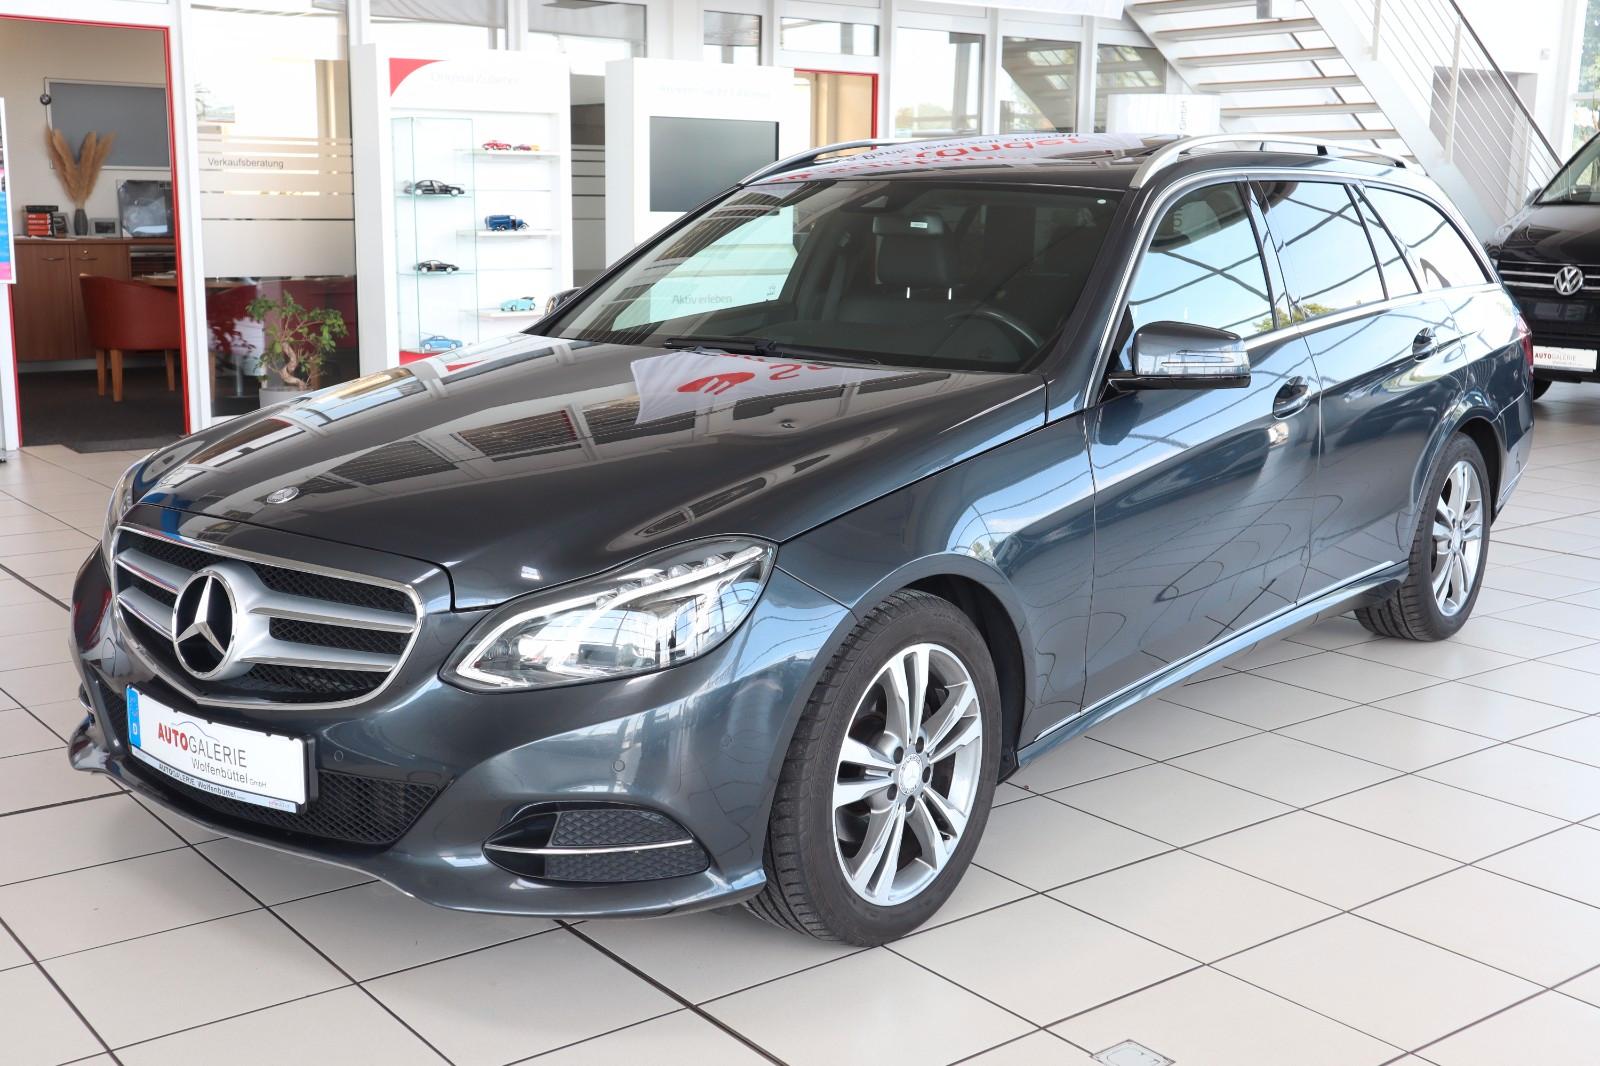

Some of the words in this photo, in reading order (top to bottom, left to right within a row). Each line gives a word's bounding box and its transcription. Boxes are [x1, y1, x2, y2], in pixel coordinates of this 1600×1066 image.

[207, 157, 284, 170] Verkaufsberatung
[672, 295, 697, 305] Aktiv
[699, 294, 732, 304] erleben
[157, 722, 248, 768] AUTOGALERIE
[191, 757, 248, 784] Wolfenbüttel
[249, 777, 268, 788] GmbH
[197, 780, 237, 799] Wolfenbüttel
